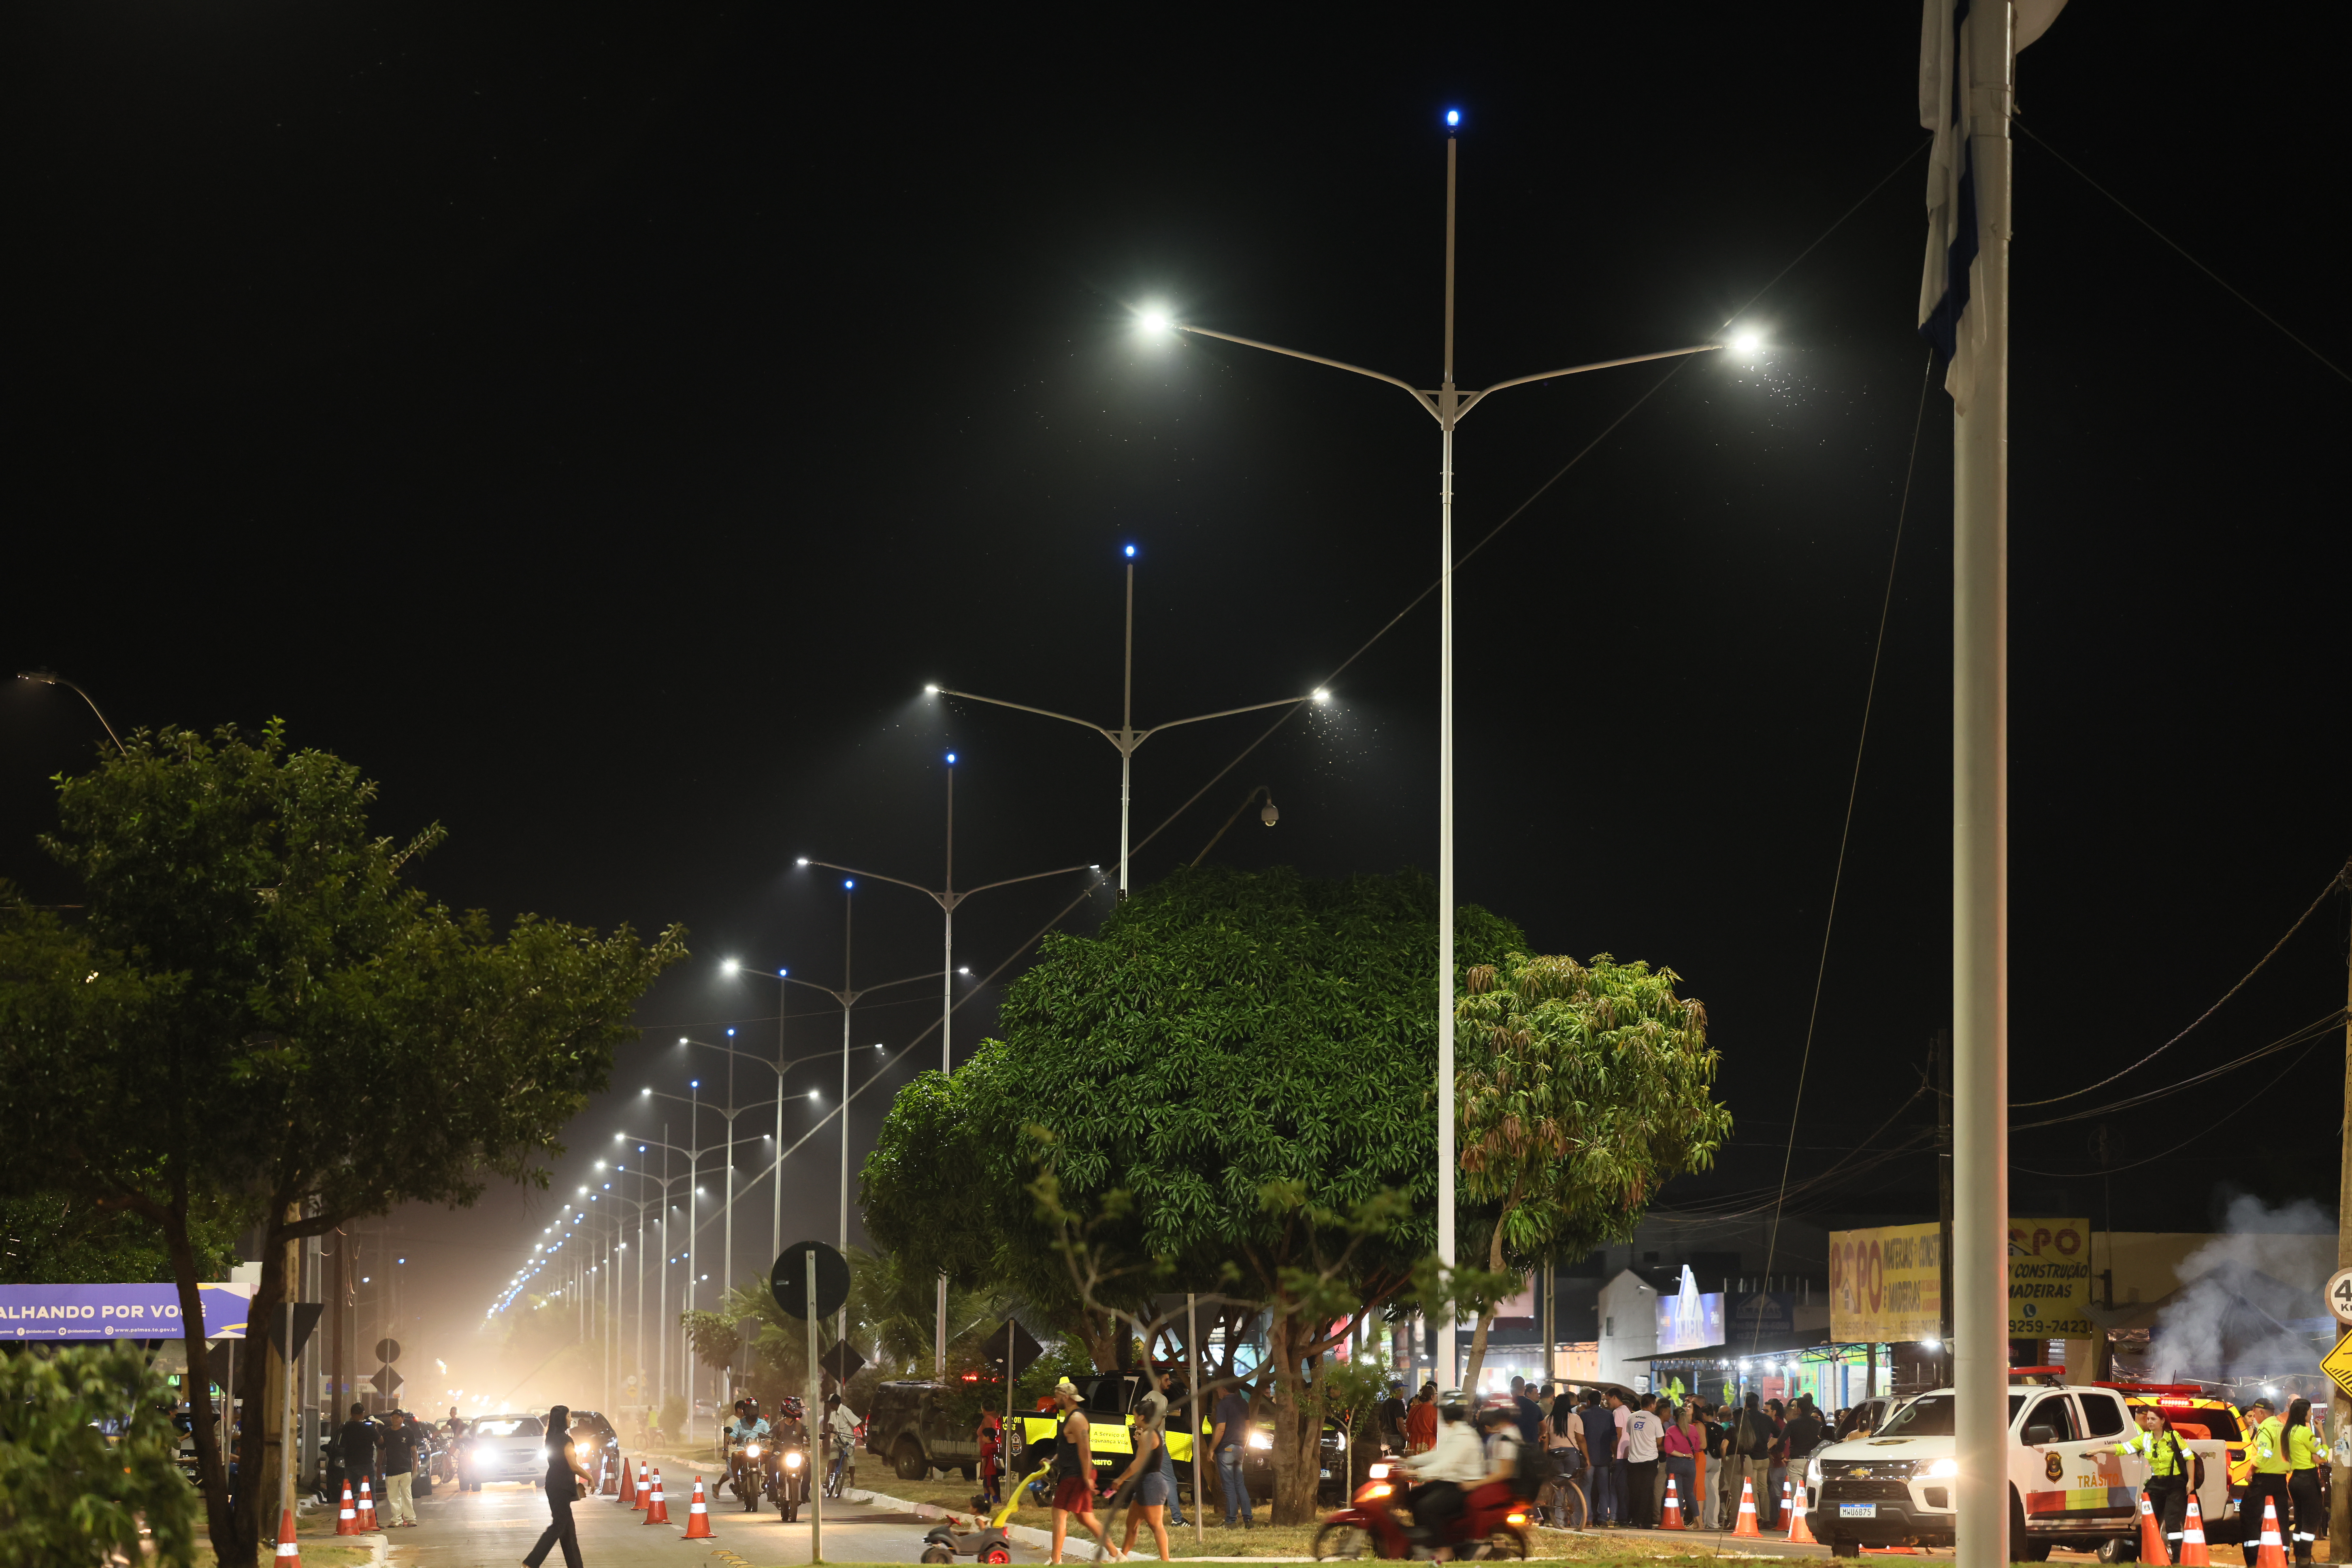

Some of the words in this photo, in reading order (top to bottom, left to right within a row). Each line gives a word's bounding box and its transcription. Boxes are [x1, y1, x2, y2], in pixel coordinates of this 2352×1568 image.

[1919, 1234, 1940, 1267] CONST
[2014, 1262, 2088, 1280] CONSTRUÇÃO
[1888, 1280, 1920, 1313] MADEIRAS
[102, 1305, 144, 1318] POR
[150, 1301, 206, 1318] VO
[931, 1439, 956, 1453] GUARDA
